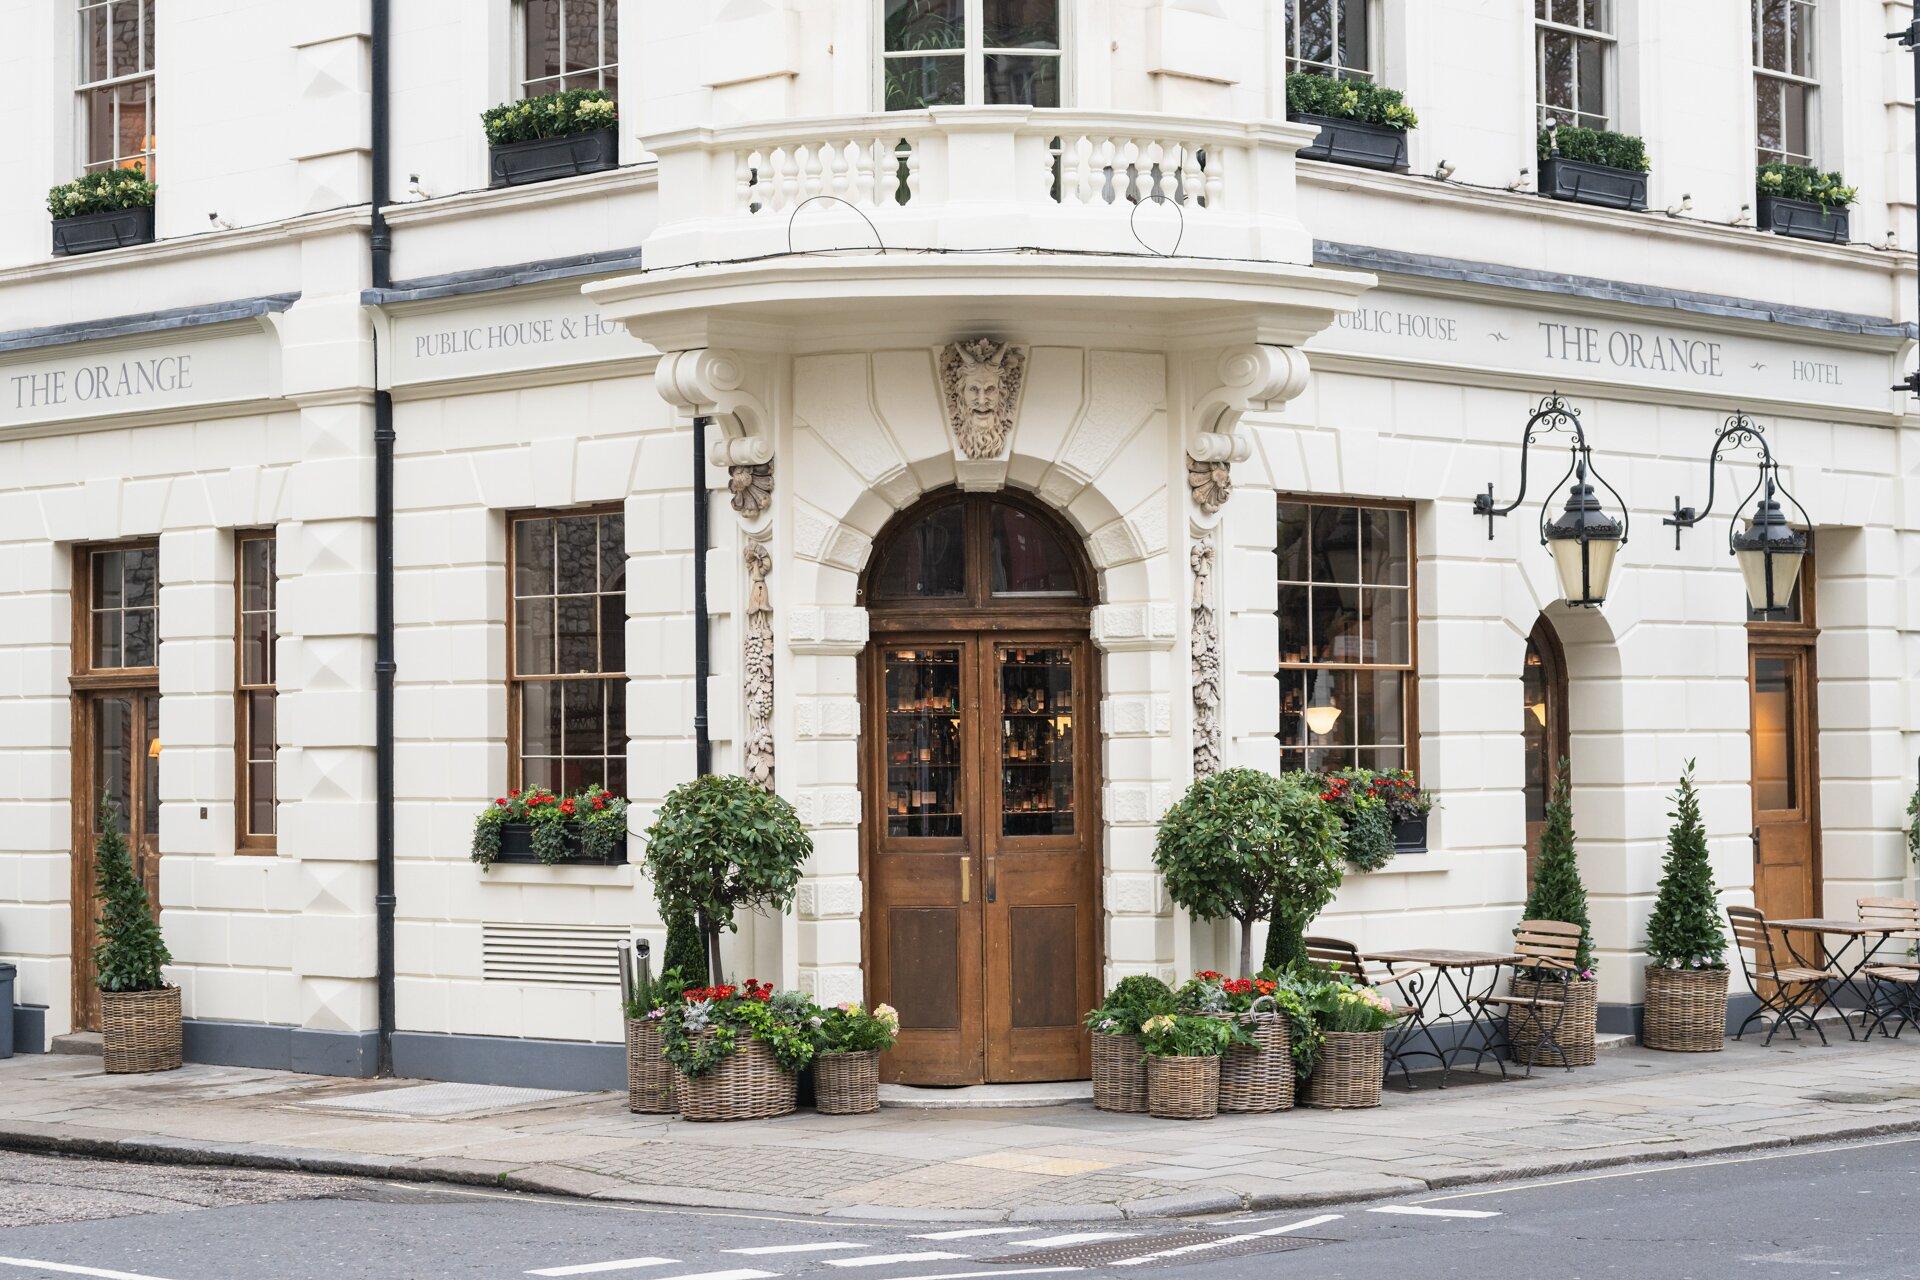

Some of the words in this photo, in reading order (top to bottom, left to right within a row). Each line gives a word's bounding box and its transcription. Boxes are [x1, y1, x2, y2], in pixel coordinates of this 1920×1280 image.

[415, 328, 482, 358] PUBLIC
[487, 319, 554, 349] HOUSE
[560, 317, 577, 340] &
[1337, 308, 1392, 334] UBLIC
[1397, 312, 1457, 342] HOUSE
[1538, 321, 1601, 364] THE
[1608, 331, 1723, 377] ORANGE
[10, 371, 67, 409] THE
[74, 355, 193, 401] ORANGE
[1792, 360, 1843, 385] HOTEL
